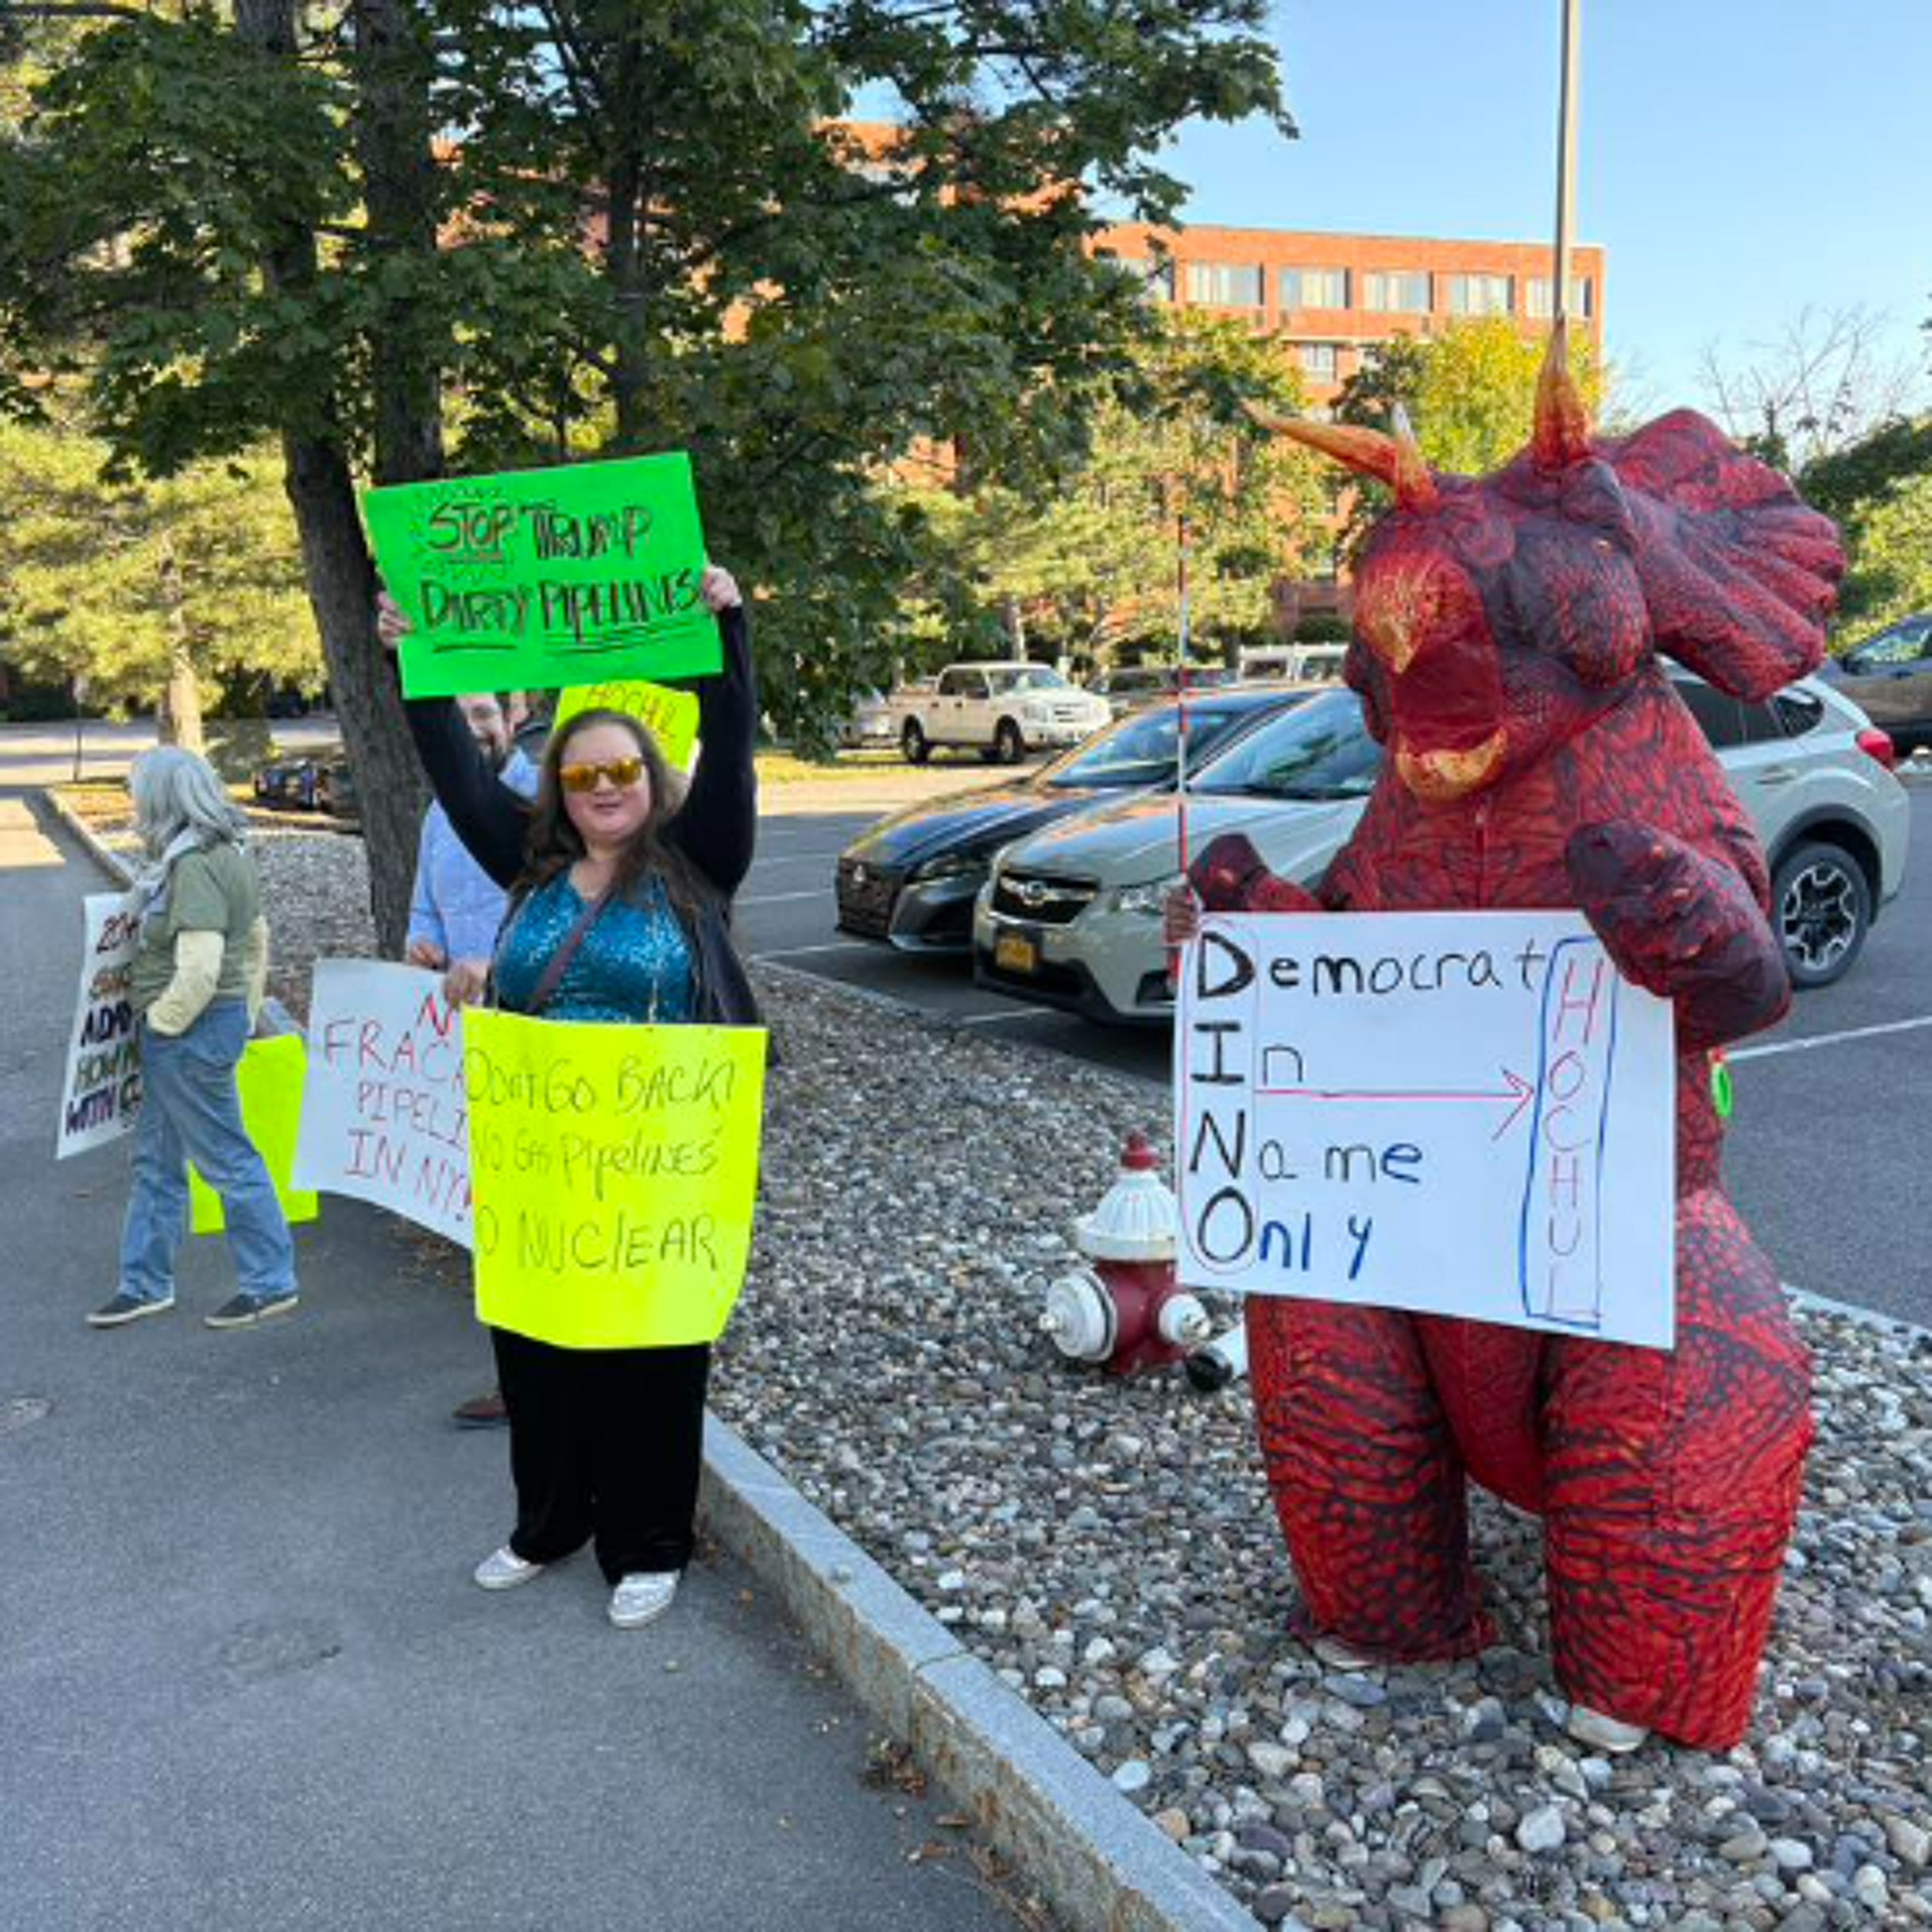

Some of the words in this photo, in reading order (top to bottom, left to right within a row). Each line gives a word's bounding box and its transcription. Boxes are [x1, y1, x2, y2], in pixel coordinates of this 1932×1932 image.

[428, 501, 513, 553] STOP
[519, 502, 652, 560] TRUMP
[1195, 930, 1547, 999] Democrat
[1189, 1021, 1304, 1086] In
[358, 1081, 468, 1151] PIPELI
[1188, 1109, 1424, 1180] Name
[1197, 1185, 1374, 1280] Only
